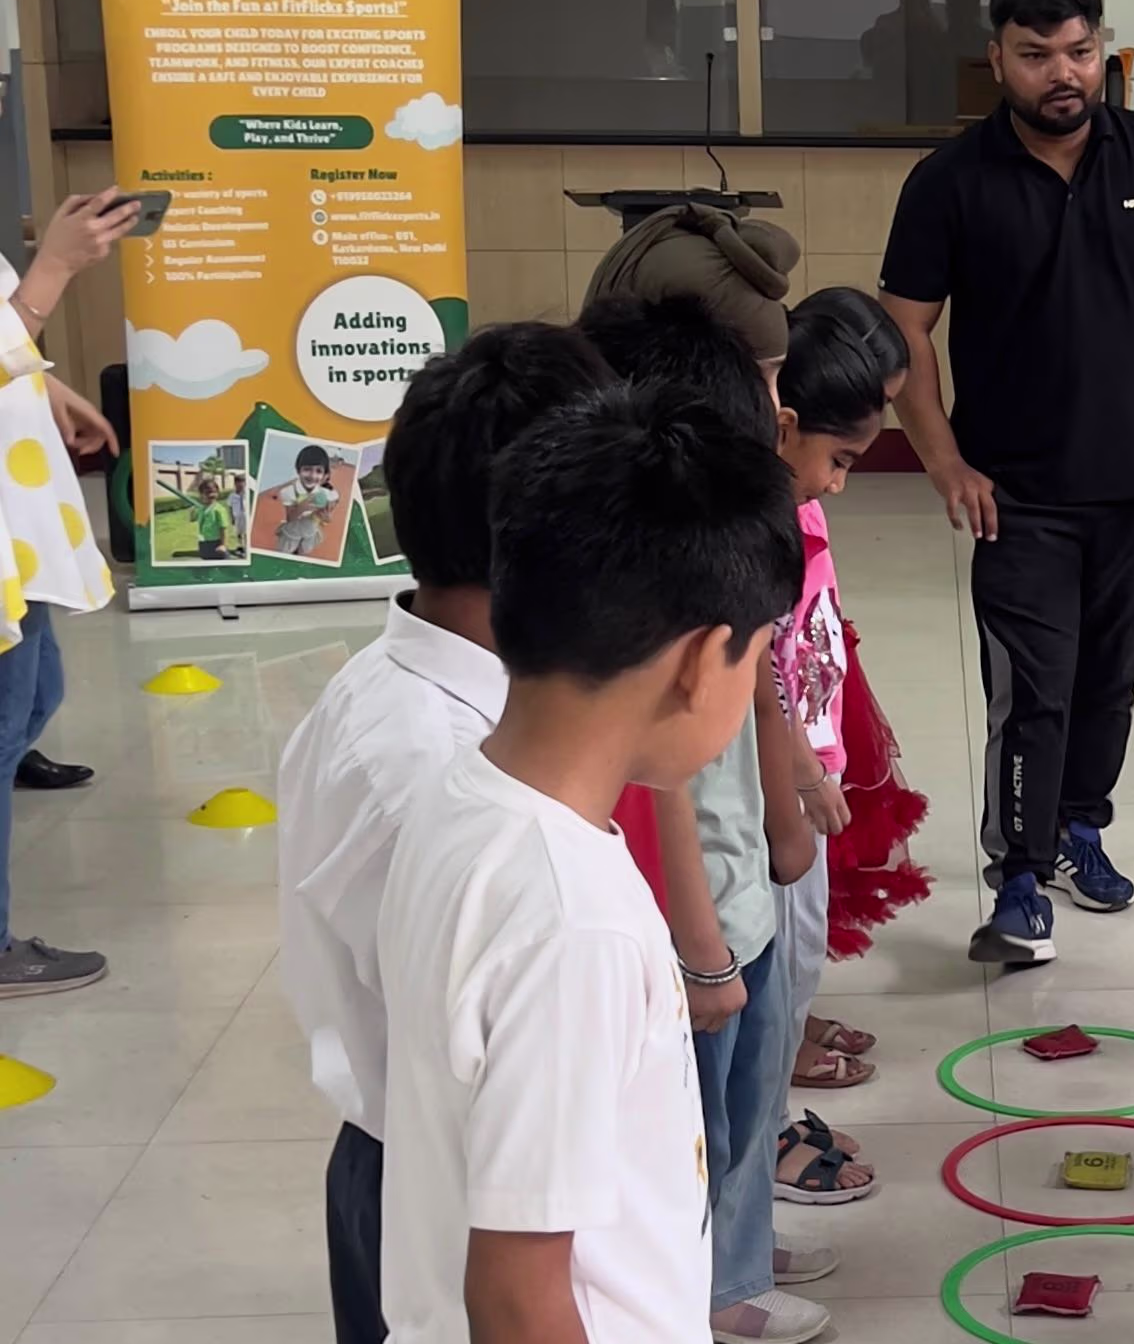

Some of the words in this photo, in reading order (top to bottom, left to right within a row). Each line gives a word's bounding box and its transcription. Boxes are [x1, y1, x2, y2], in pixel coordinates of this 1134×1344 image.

[262, 0, 279, 13] at
[144, 27, 187, 38] ENROLL
[189, 27, 222, 38] YOUR
[223, 28, 259, 39] CHILD
[260, 28, 300, 39] TODAY
[301, 28, 325, 39] FOR
[326, 28, 381, 39] EXCITING
[383, 29, 426, 40] SPORTS
[156, 42, 223, 53] PROGRAMS
[224, 43, 282, 54] DESIGNED
[283, 43, 300, 54] TO
[301, 43, 340, 54] BOOST
[149, 57, 223, 68] TEAMWORK,
[224, 58, 249, 69] AND
[302, 58, 327, 69] OUR
[328, 58, 370, 69] EXPERT
[371, 59, 424, 70] COACHES
[151, 71, 196, 83] ENSURE
[197, 71, 208, 83] A
[208, 72, 236, 84] SAFE
[237, 72, 263, 84] AND
[263, 72, 329, 84] ENJOYABLE
[330, 73, 399, 85] EXPERIENCE
[401, 73, 423, 85] FOR
[252, 86, 290, 97] EVERY
[291, 86, 327, 97] CHILD
[283, 119, 307, 130] Kids
[309, 120, 343, 131] Learn,
[244, 132, 272, 144] Play,
[274, 133, 295, 143] and
[141, 169, 204, 181] Activities
[310, 168, 366, 183] Register
[368, 168, 398, 180] Now
[222, 188, 234, 198] of
[422, 243, 447, 252] Delhi
[333, 312, 407, 332] Adding
[311, 338, 431, 357] innovations
[328, 365, 347, 383] in
[1012, 754, 1023, 798] ACTIVE
